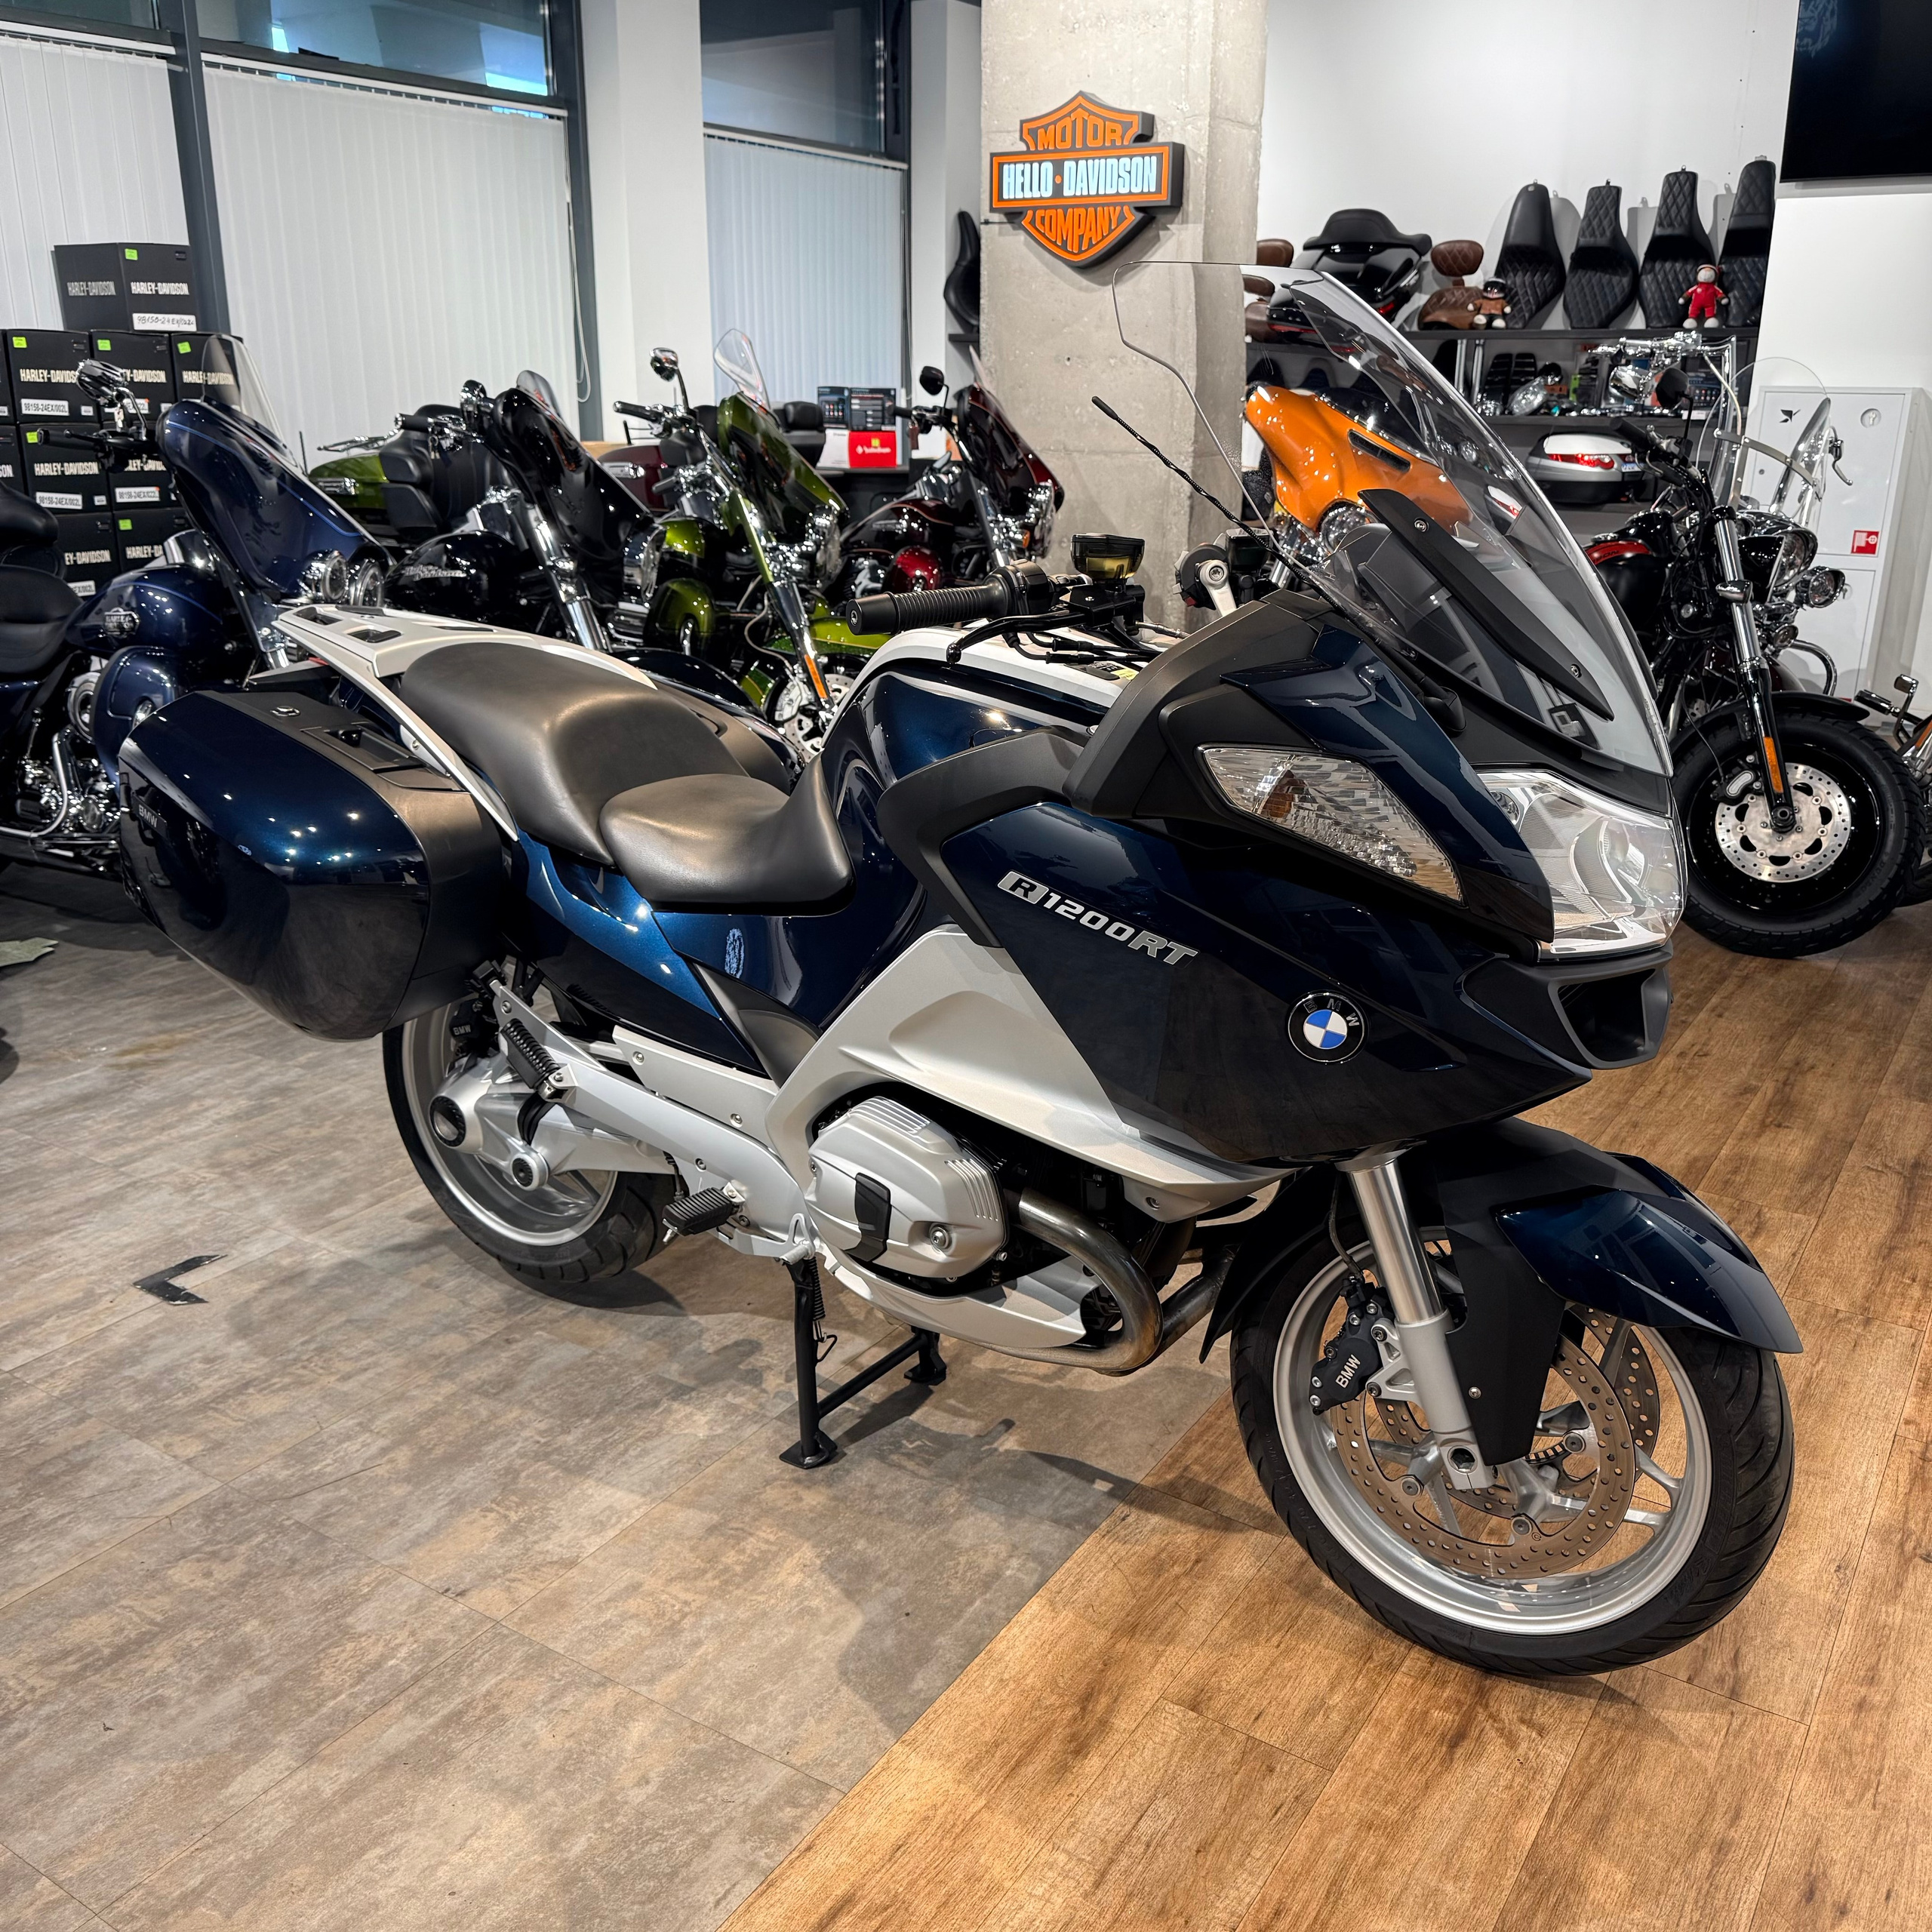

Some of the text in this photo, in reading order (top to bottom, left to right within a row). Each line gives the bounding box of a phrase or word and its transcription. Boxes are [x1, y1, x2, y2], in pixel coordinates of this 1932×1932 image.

[1037, 107, 1123, 150] MOTOR
[1002, 155, 1157, 199] HELLO DAVIDSON
[1035, 205, 1121, 253] COMPANY
[67, 281, 116, 296] HARLEY-DAVIDSON
[131, 281, 189, 295] HARLEY-DAVIDSON
[20, 368, 76, 383] HARLEY-DAVIDS
[34, 462, 100, 475] HARLEY-DAVIDSON
[138, 804, 158, 828] BMW
[1303, 998, 1360, 1026] BMW
[453, 1024, 472, 1035] BMW
[1336, 1354, 1361, 1388] BMW
